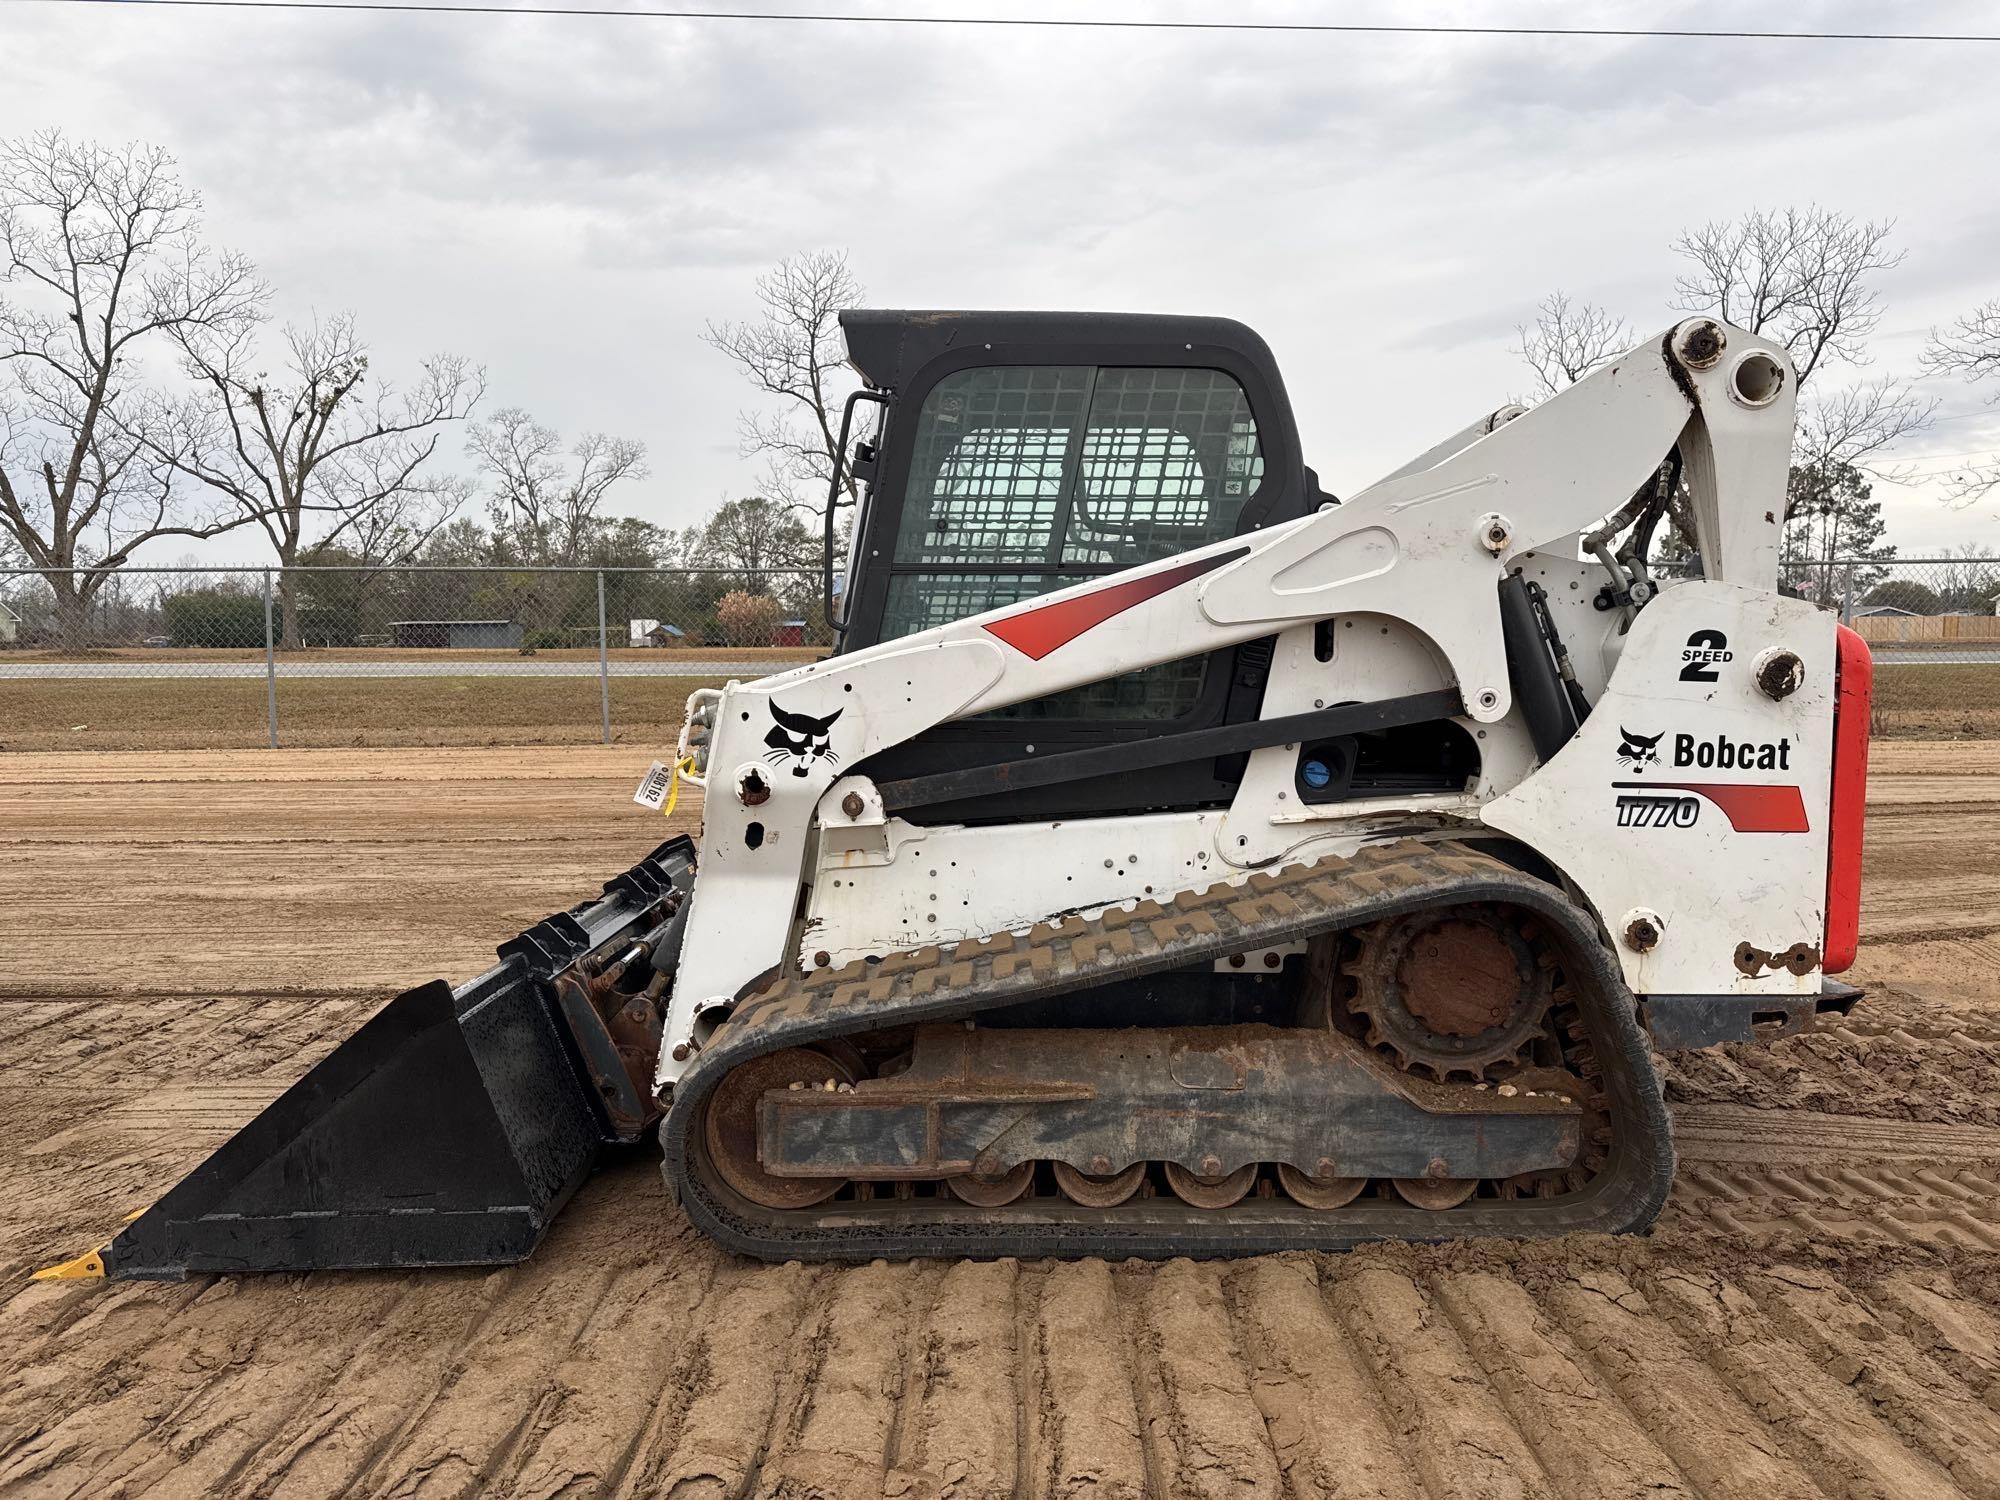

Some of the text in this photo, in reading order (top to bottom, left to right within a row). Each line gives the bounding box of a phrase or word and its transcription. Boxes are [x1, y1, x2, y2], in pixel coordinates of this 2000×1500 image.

[1678, 629, 1728, 682] 2
[1681, 649, 1733, 663] SPEED
[1673, 733, 1790, 770] Bobcat
[645, 772, 669, 802] 208162
[1615, 795, 1700, 828] T770
